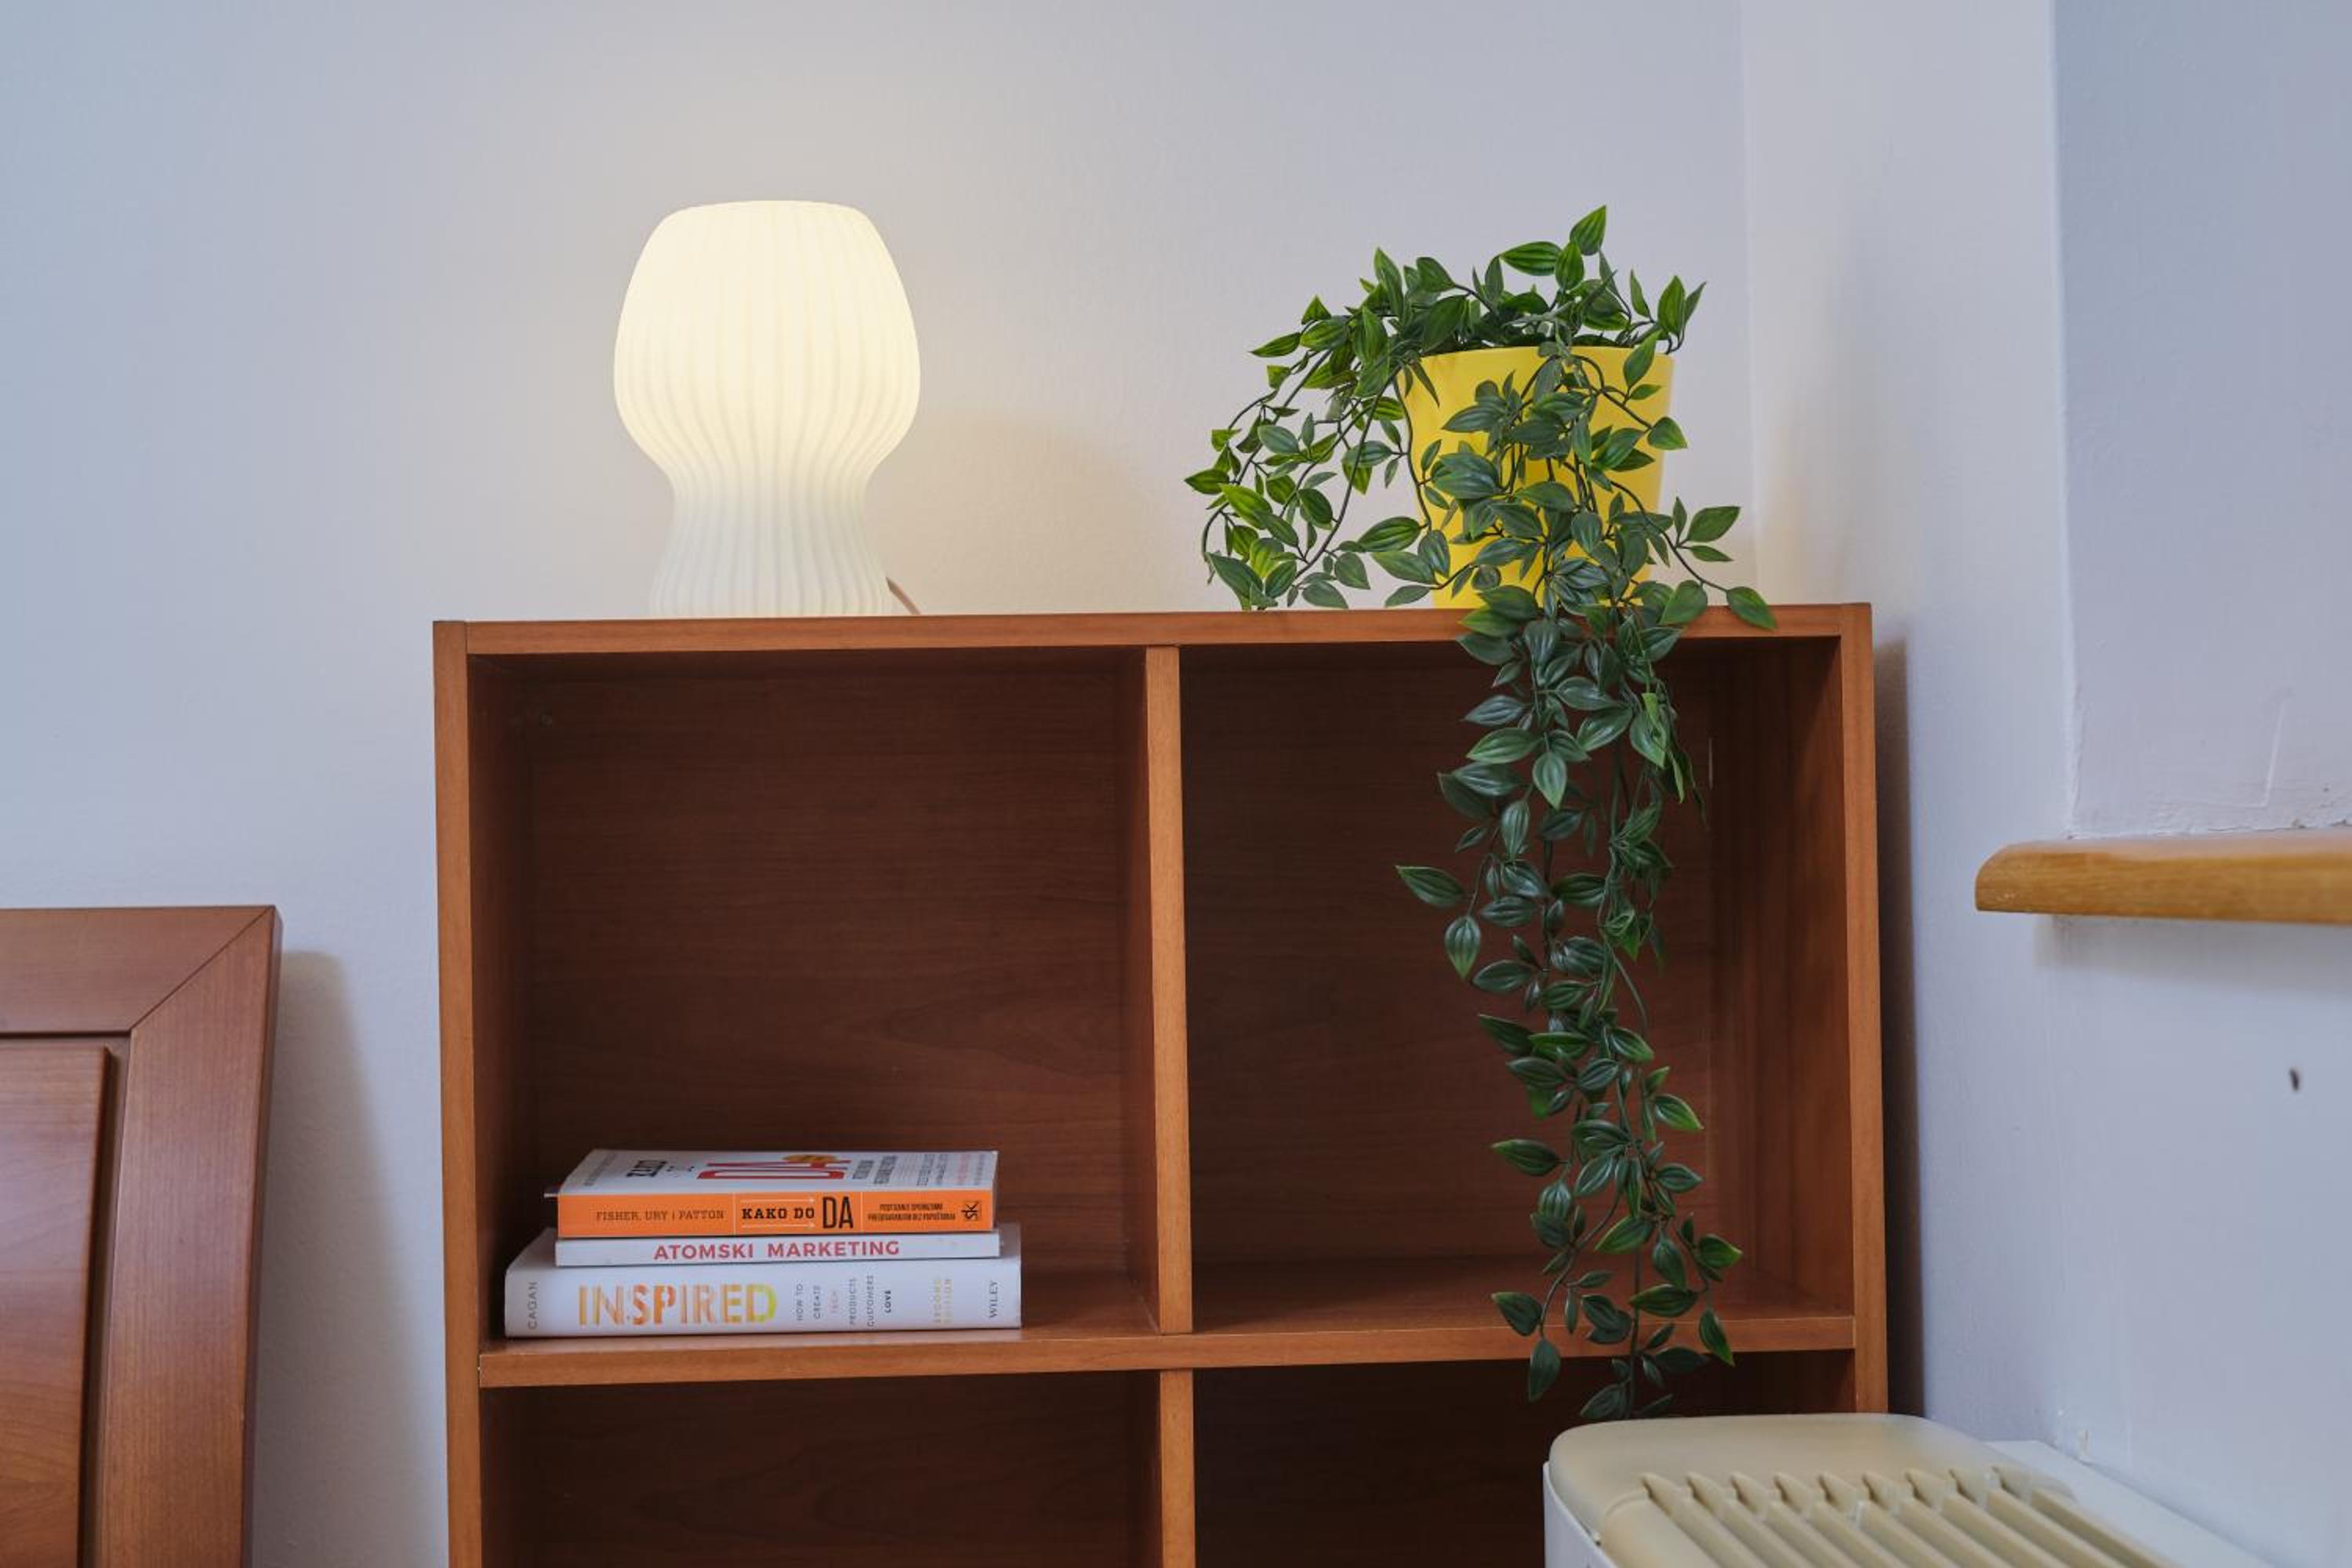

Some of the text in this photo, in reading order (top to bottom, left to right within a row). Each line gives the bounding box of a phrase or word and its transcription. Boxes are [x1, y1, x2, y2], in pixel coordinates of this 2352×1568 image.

[645, 1210, 667, 1221] URY
[679, 1210, 724, 1220] PATTON
[742, 1196, 854, 1229] KAKO DO DA
[654, 1240, 899, 1260] ATOMSKI MARKETING
[796, 1283, 803, 1296] TO
[528, 1280, 538, 1330] CAGAN
[578, 1283, 778, 1326] INSPIRED
